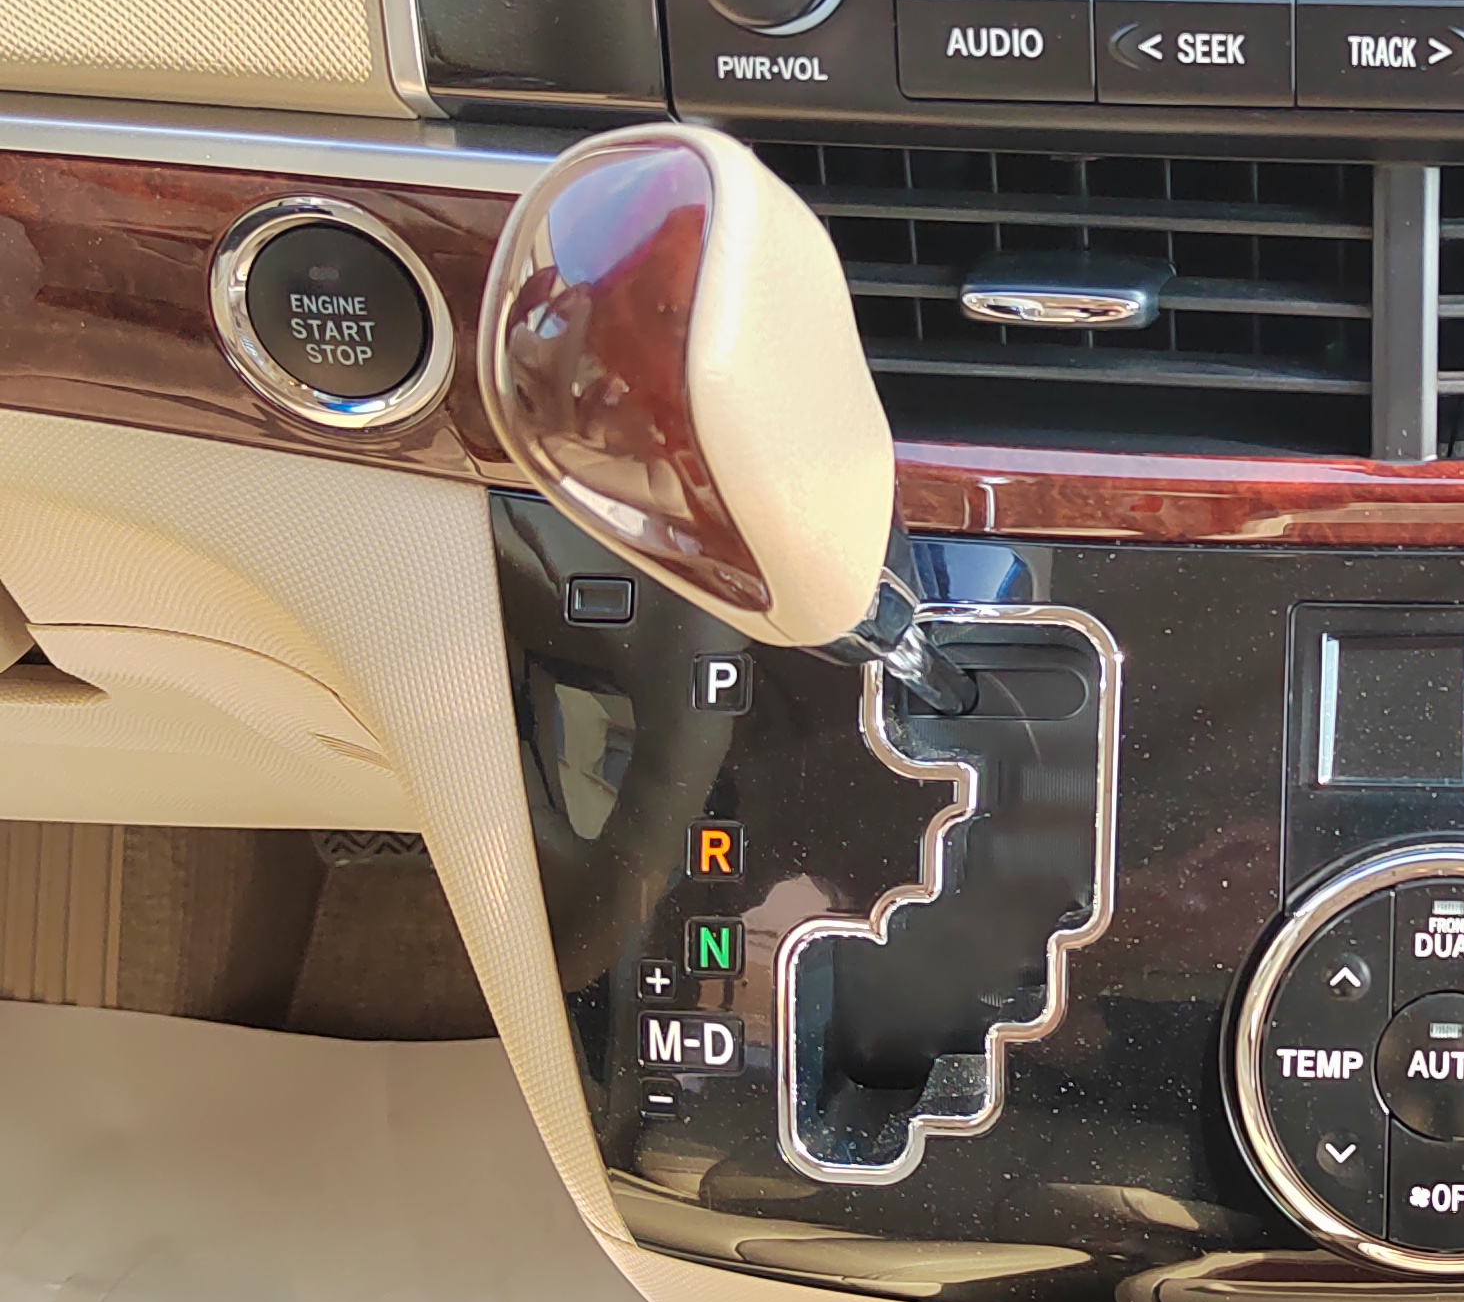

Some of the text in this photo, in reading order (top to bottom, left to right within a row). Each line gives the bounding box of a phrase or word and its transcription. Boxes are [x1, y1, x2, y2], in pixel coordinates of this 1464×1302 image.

[946, 27, 1044, 58] AUDIO
[1177, 32, 1245, 65] SEEK
[1347, 35, 1417, 68] TRACK
[289, 294, 368, 315] ENGINE
[290, 317, 375, 342] START
[305, 343, 372, 366] STOP
[707, 662, 738, 704] P
[700, 830, 732, 874] R
[699, 926, 732, 972] N
[649, 1019, 734, 1066] M-D
[1276, 1048, 1364, 1080] TEMP
